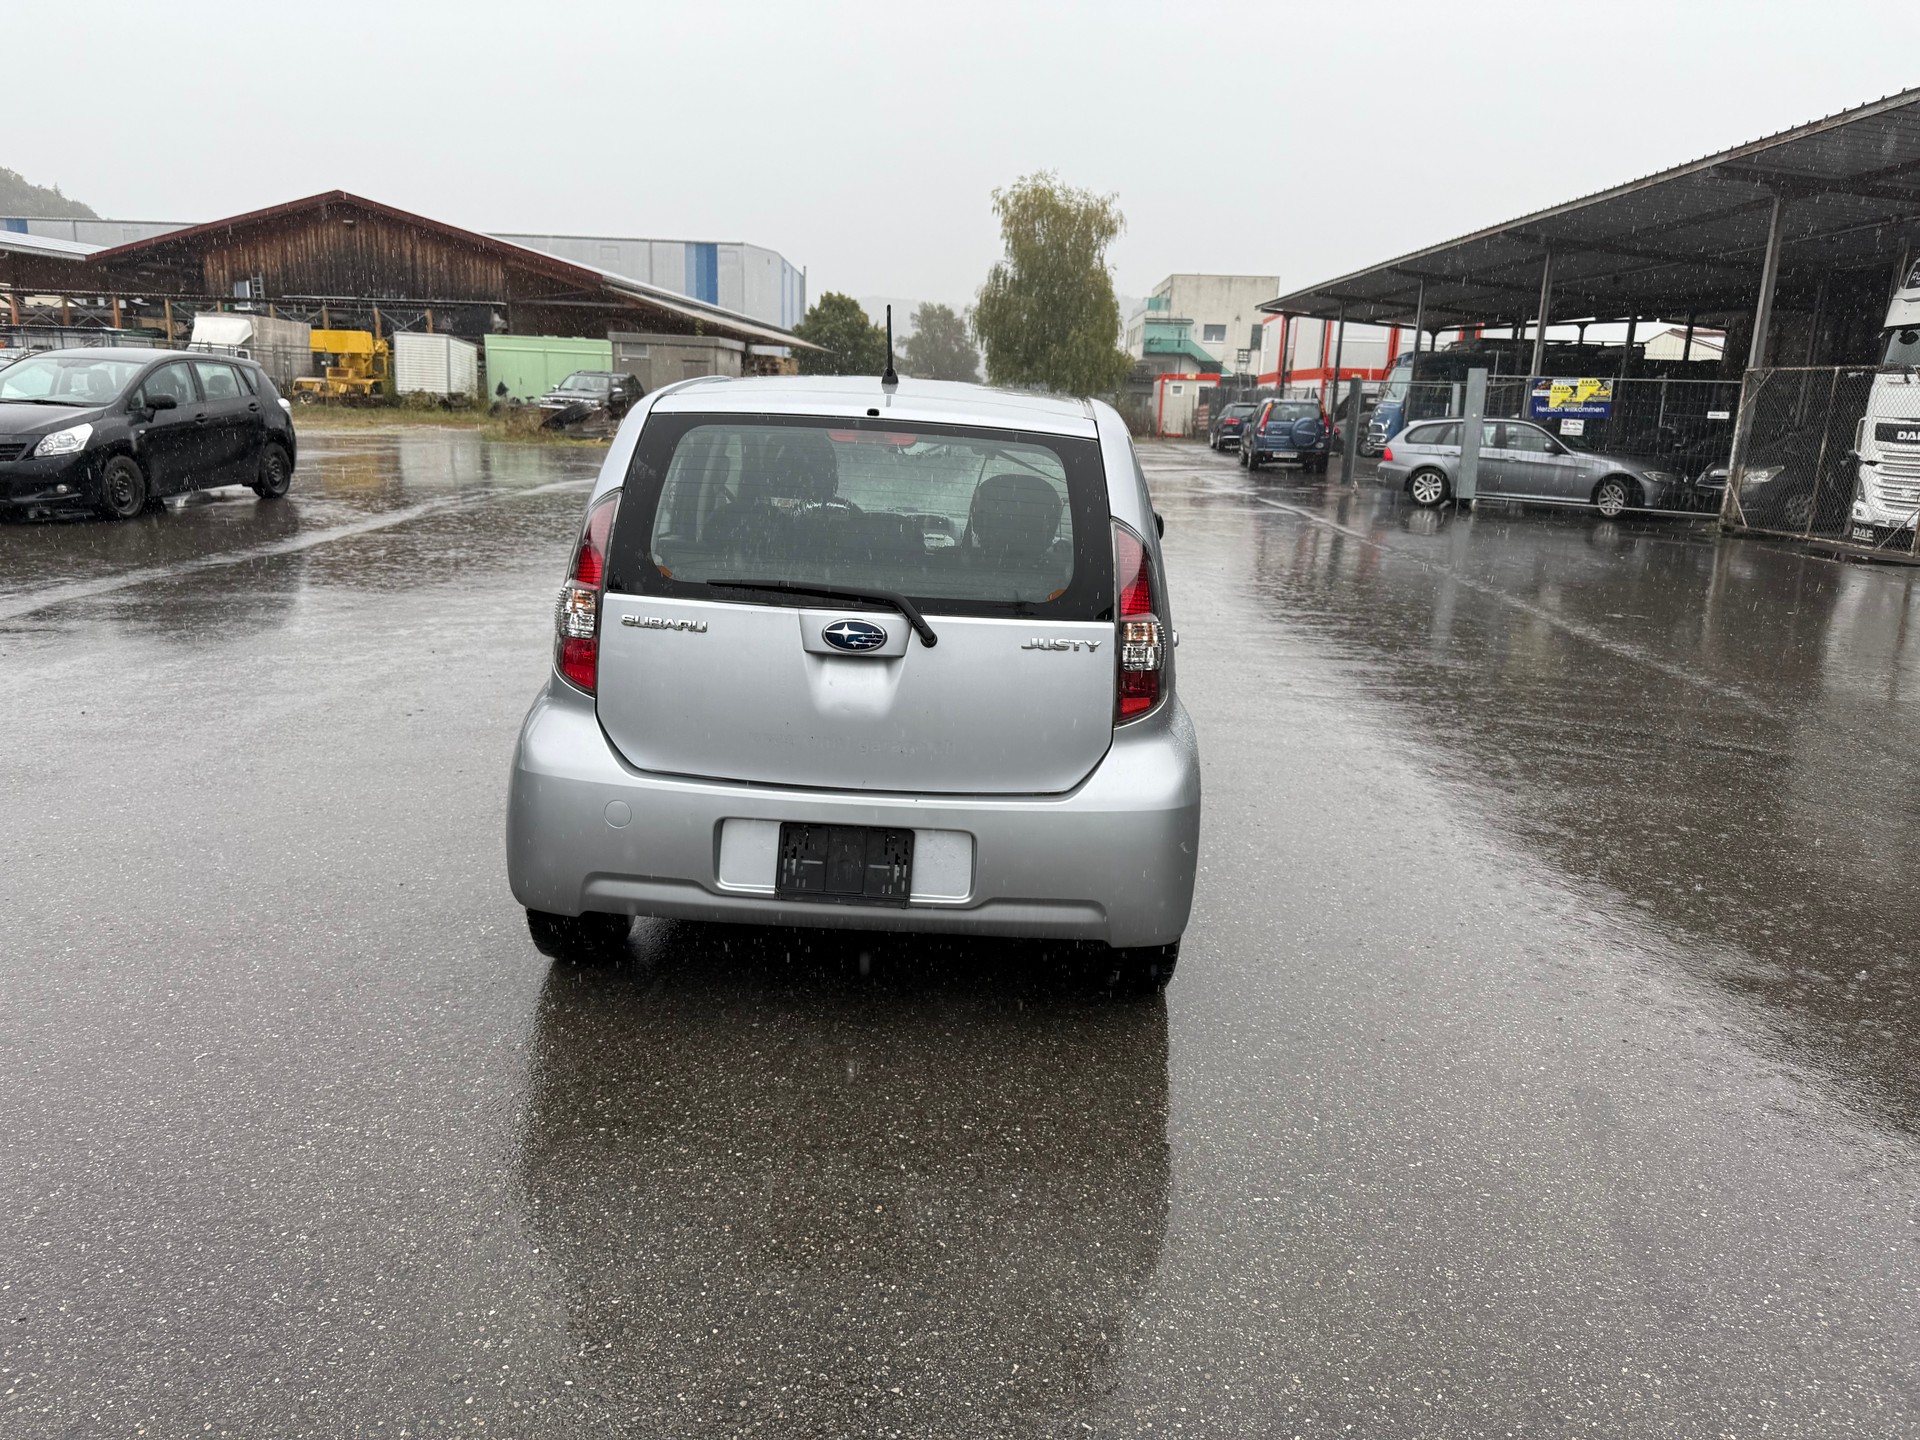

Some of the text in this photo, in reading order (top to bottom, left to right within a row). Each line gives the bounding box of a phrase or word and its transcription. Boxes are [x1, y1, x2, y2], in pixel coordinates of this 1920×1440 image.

[1852, 527, 1874, 538] DAF
[621, 614, 708, 633] SUBARU
[1021, 637, 1102, 653] JUSTY
